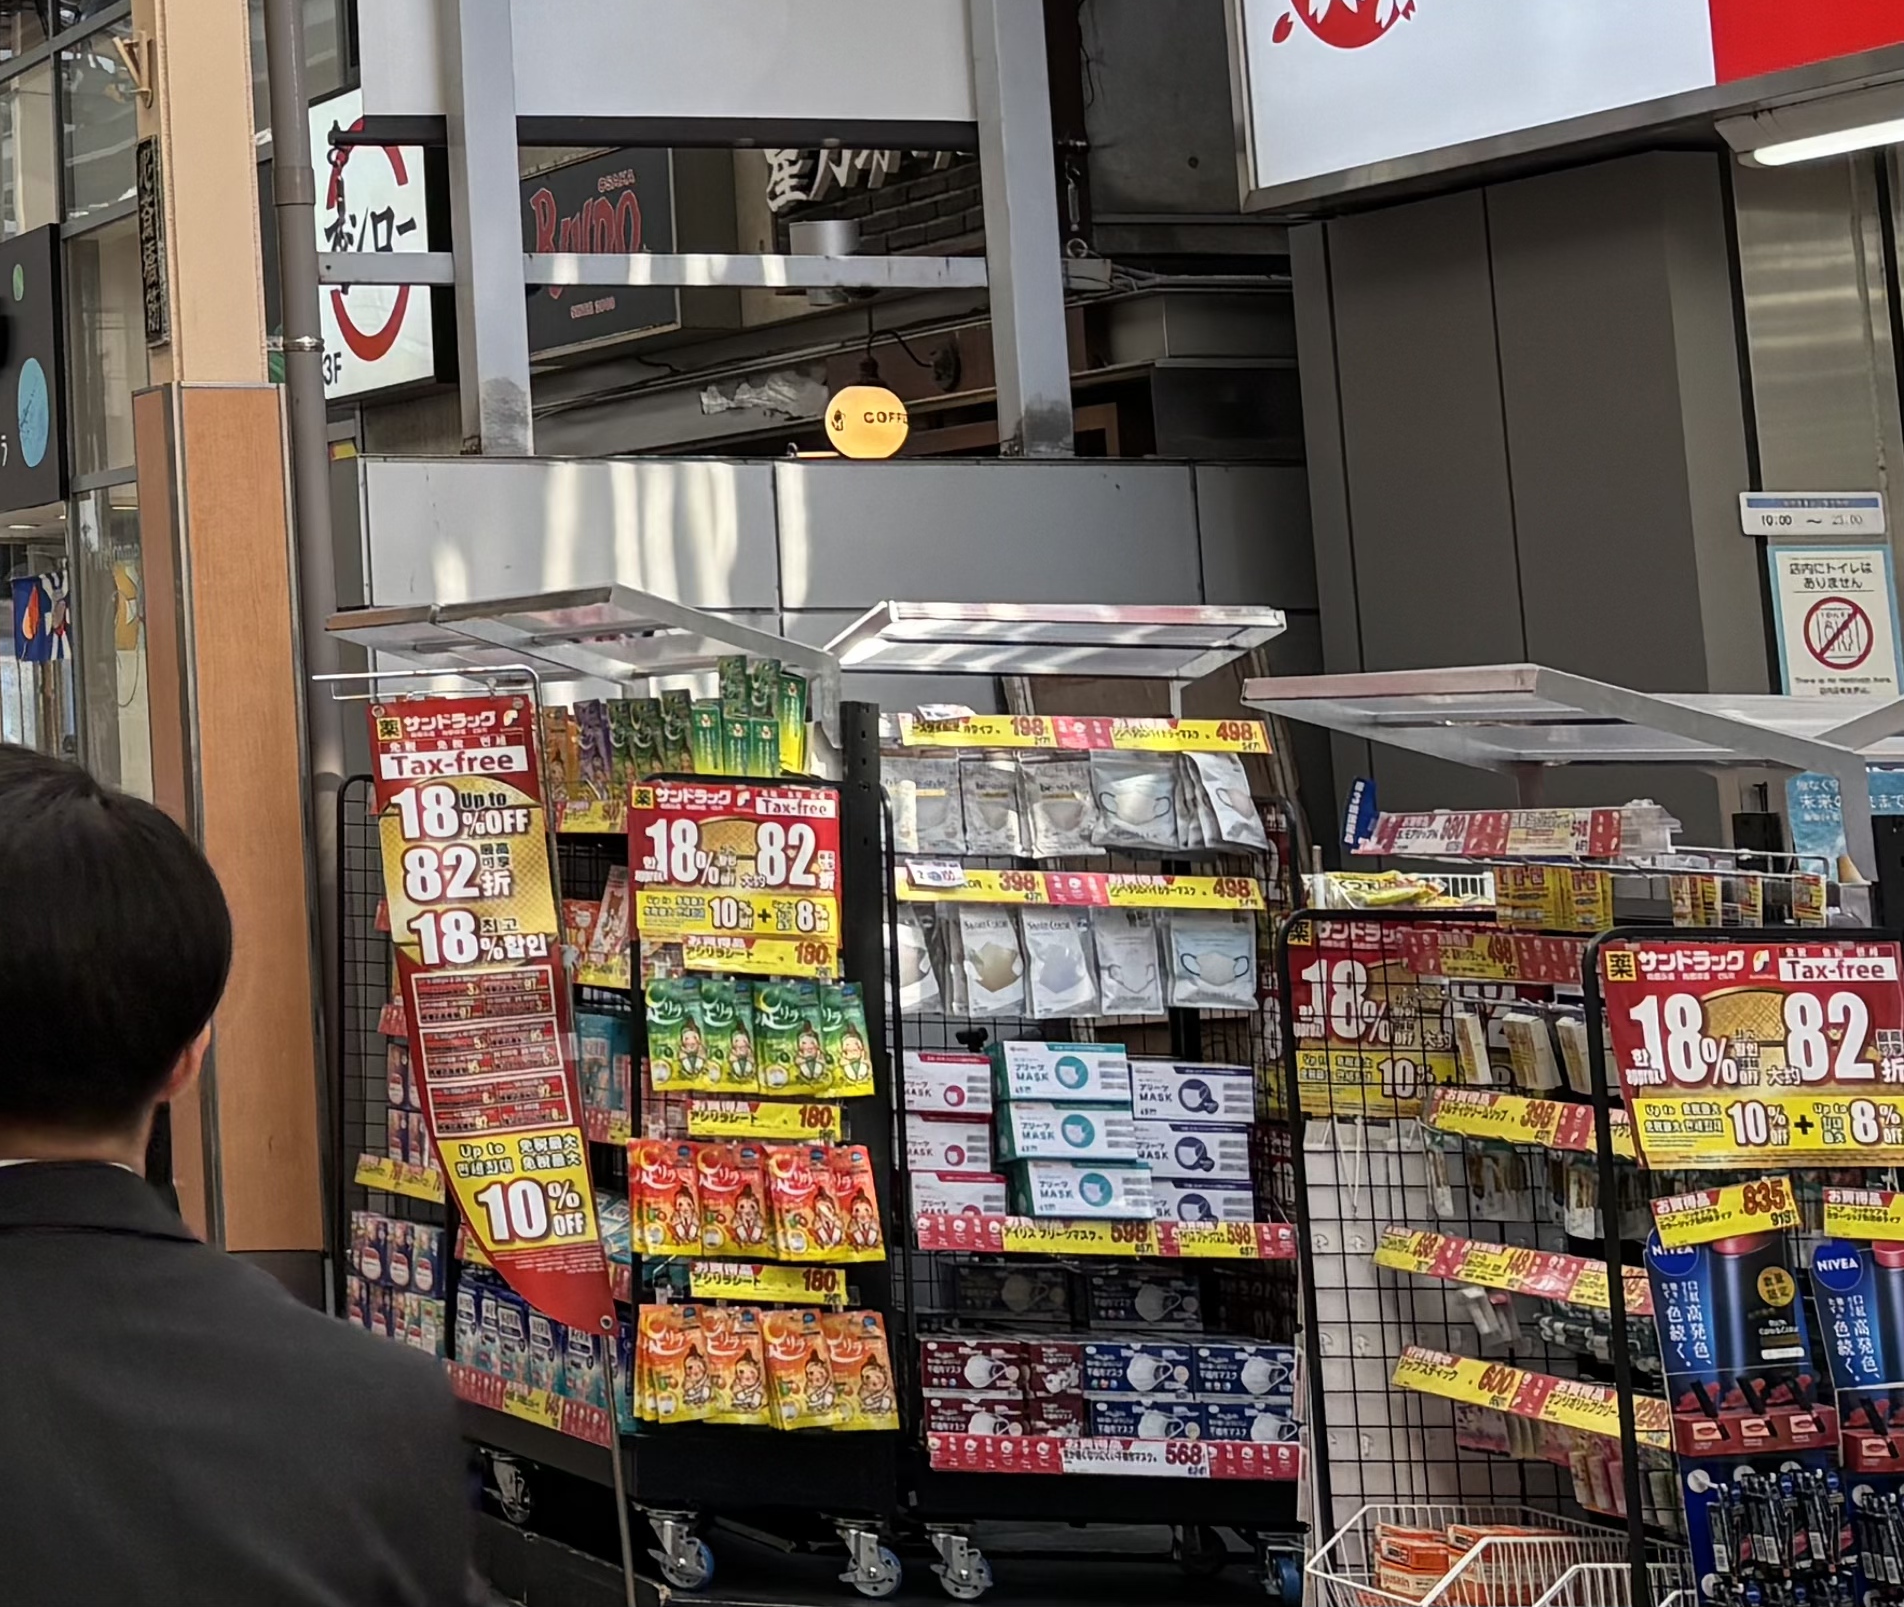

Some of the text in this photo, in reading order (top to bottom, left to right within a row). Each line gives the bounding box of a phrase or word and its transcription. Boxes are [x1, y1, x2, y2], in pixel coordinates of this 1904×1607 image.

[1789, 562, 1873, 575] 店内にトイレは
[1803, 577, 1863, 589] ありません
[403, 710, 497, 732] サンドラッグ
[391, 750, 514, 777] Tax-free
[390, 785, 460, 840] 18
[460, 792, 507, 809] Up to
[762, 799, 828, 815] Tax-free
[644, 818, 699, 884] 18
[757, 822, 817, 886] 82
[403, 845, 480, 902] 82
[480, 872, 512, 897] 折
[409, 910, 479, 965] 18
[1637, 950, 1745, 972] サンドラッグ
[1787, 959, 1886, 980] Tax-free
[1301, 958, 1368, 1040] 18
[1629, 992, 1708, 1084] 18
[1784, 991, 1876, 1082] 82
[1015, 1072, 1049, 1083] MASK
[1139, 1092, 1173, 1103] MASK
[1727, 1100, 1768, 1146] 10
[1850, 1098, 1879, 1145] 8
[459, 1142, 506, 1159] Up to
[547, 1181, 581, 1210] %
[475, 1179, 549, 1242] 10
[553, 1213, 586, 1237] OFF
[1816, 1257, 1859, 1272] NIVEA
